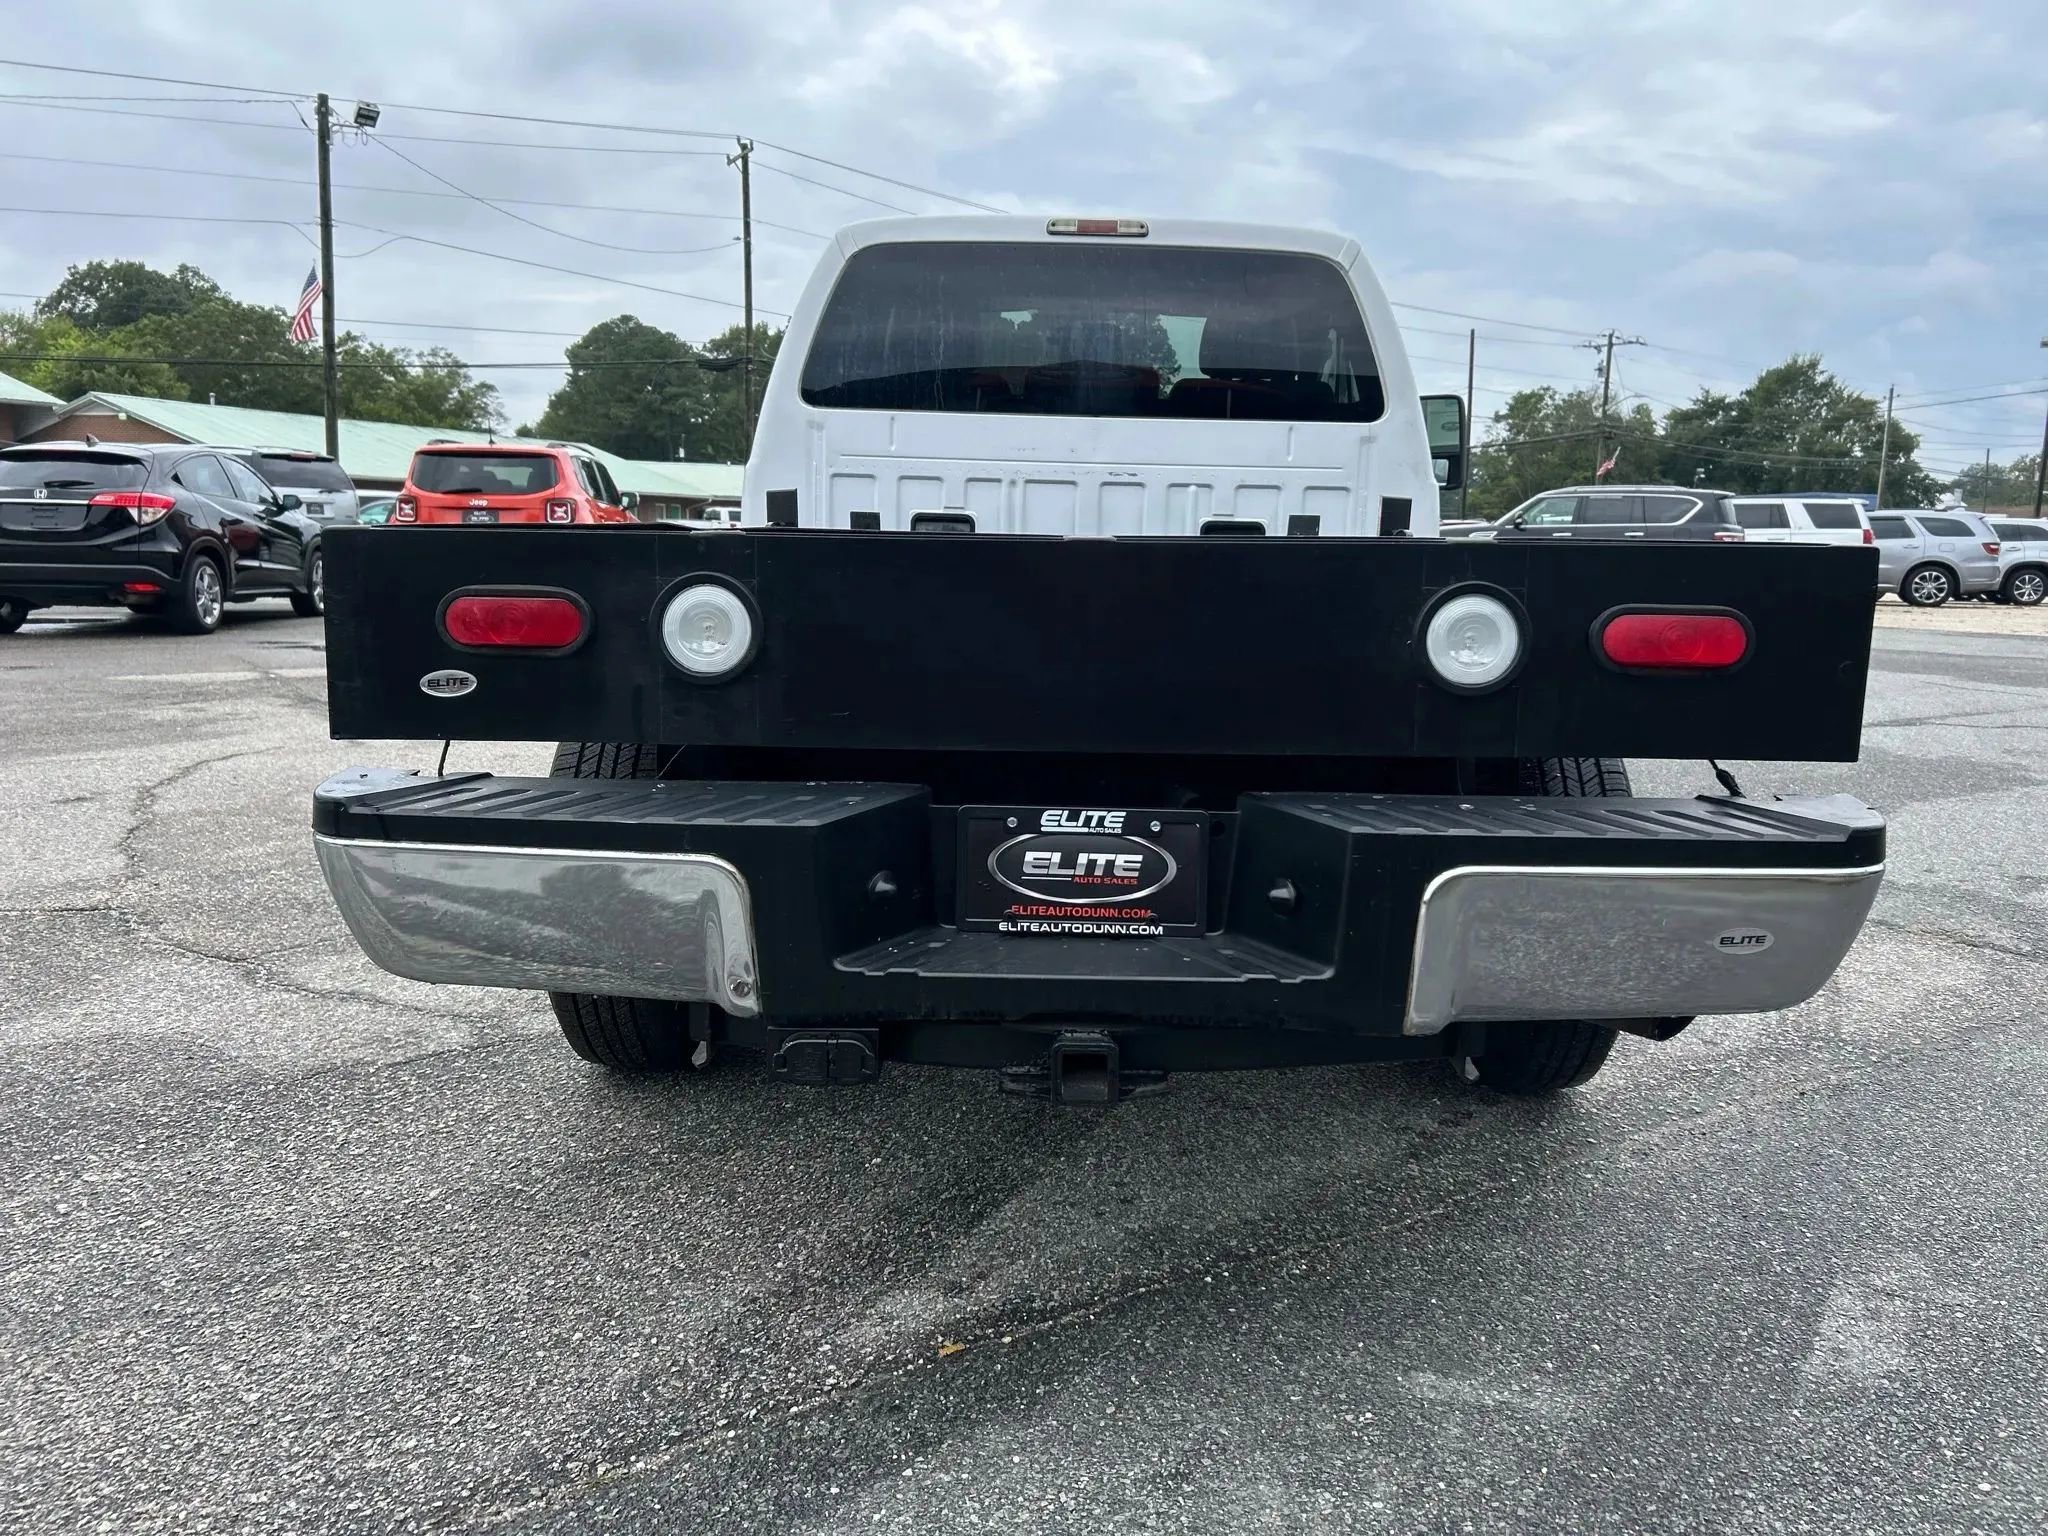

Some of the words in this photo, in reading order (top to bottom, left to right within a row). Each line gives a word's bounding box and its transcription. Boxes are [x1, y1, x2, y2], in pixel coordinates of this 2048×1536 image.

[469, 498, 488, 507] Jeep
[427, 676, 470, 688] ELITE
[1040, 809, 1127, 828] ELITE
[1022, 850, 1144, 877] ELITE
[1073, 876, 1101, 884] AUTO
[1103, 877, 1138, 885] SALES
[1011, 905, 1151, 918] ELITEAUTODUNN.COM
[998, 922, 1164, 935] ELITEAUTODUNN.COM
[1719, 934, 1768, 945] ELITE
